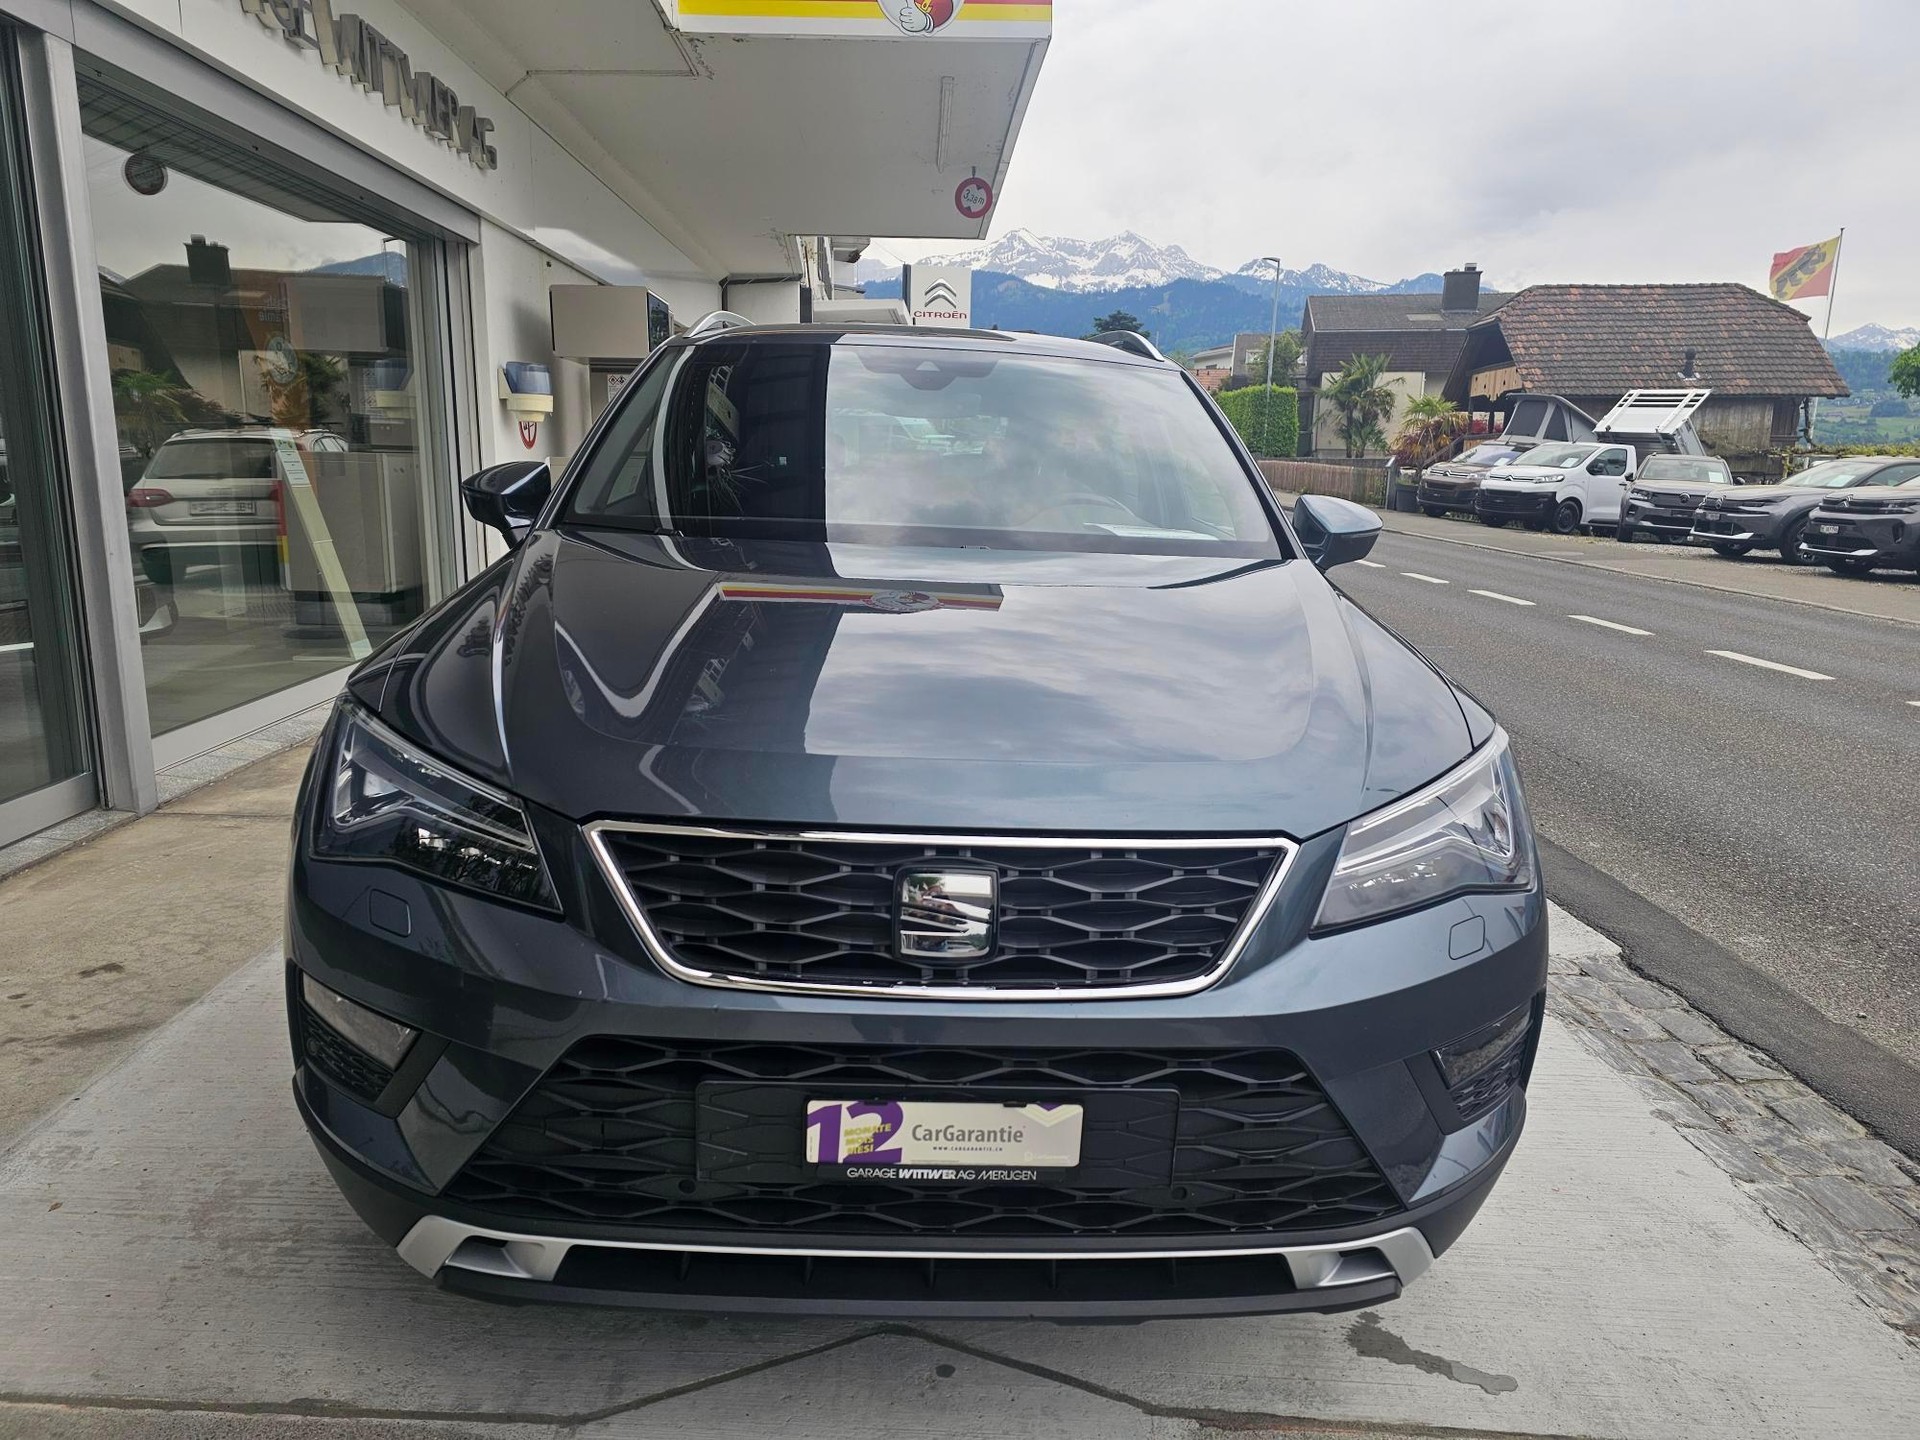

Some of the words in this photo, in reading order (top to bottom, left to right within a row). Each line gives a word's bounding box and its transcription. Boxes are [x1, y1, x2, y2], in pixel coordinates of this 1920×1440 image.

[807, 1101, 904, 1163] 12
[844, 1123, 892, 1137] MONATE
[912, 1124, 1024, 1143] CarGarantie
[846, 1167, 897, 1179] GARAGE
[957, 1169, 975, 1180] AG
